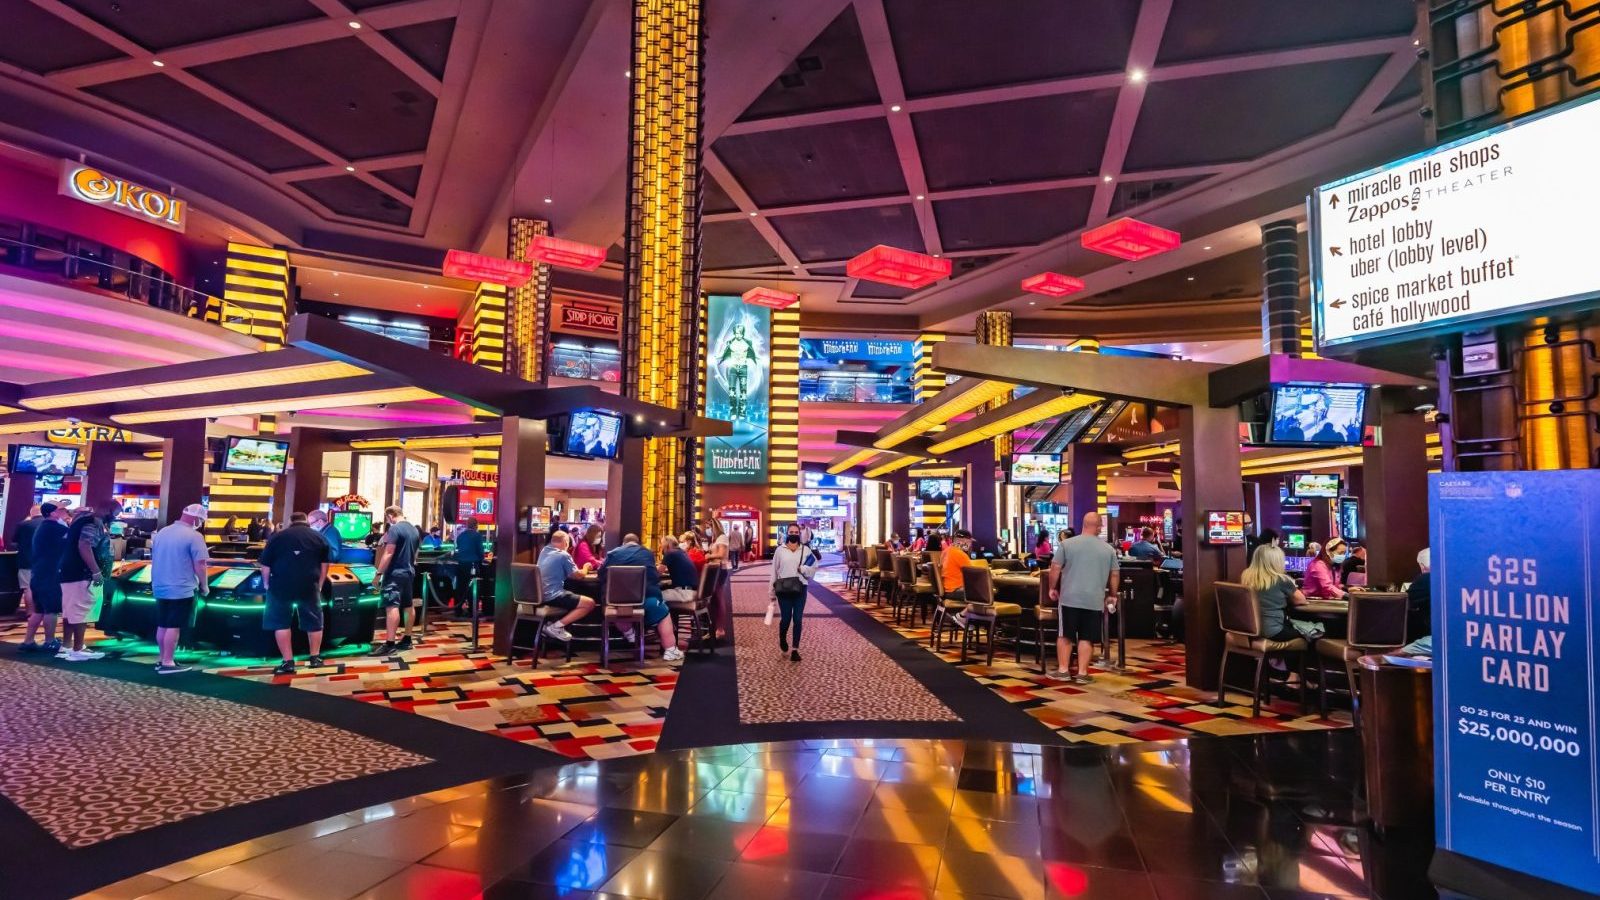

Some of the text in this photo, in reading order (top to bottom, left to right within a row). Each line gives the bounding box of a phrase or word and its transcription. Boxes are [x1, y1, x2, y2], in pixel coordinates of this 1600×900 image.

[1348, 143, 1500, 204] miracle mile shops
[114, 179, 182, 223] KOI
[1347, 166, 1514, 223] Zappos THEATER
[1350, 219, 1433, 255] hotel lobby
[1350, 227, 1488, 278] uber (lobby level)
[1351, 256, 1515, 311] spice market buffet
[566, 310, 616, 327] STRIP HOUSE
[1353, 290, 1470, 331] café hollywood
[460, 469, 499, 483] ROULETTE
[1488, 554, 1537, 586] $25
[1461, 587, 1569, 624] MILLION
[1466, 621, 1566, 659] PARLAY
[1482, 656, 1549, 692] CARD
[1458, 717, 1580, 757] $25,000,000
[1460, 705, 1577, 735] GO 25 FOR 25 AND WIN
[1484, 780, 1551, 805] PER ENTRY
[1488, 769, 1545, 790] ONLY $10
[1458, 792, 1583, 832] Available throughout the season
